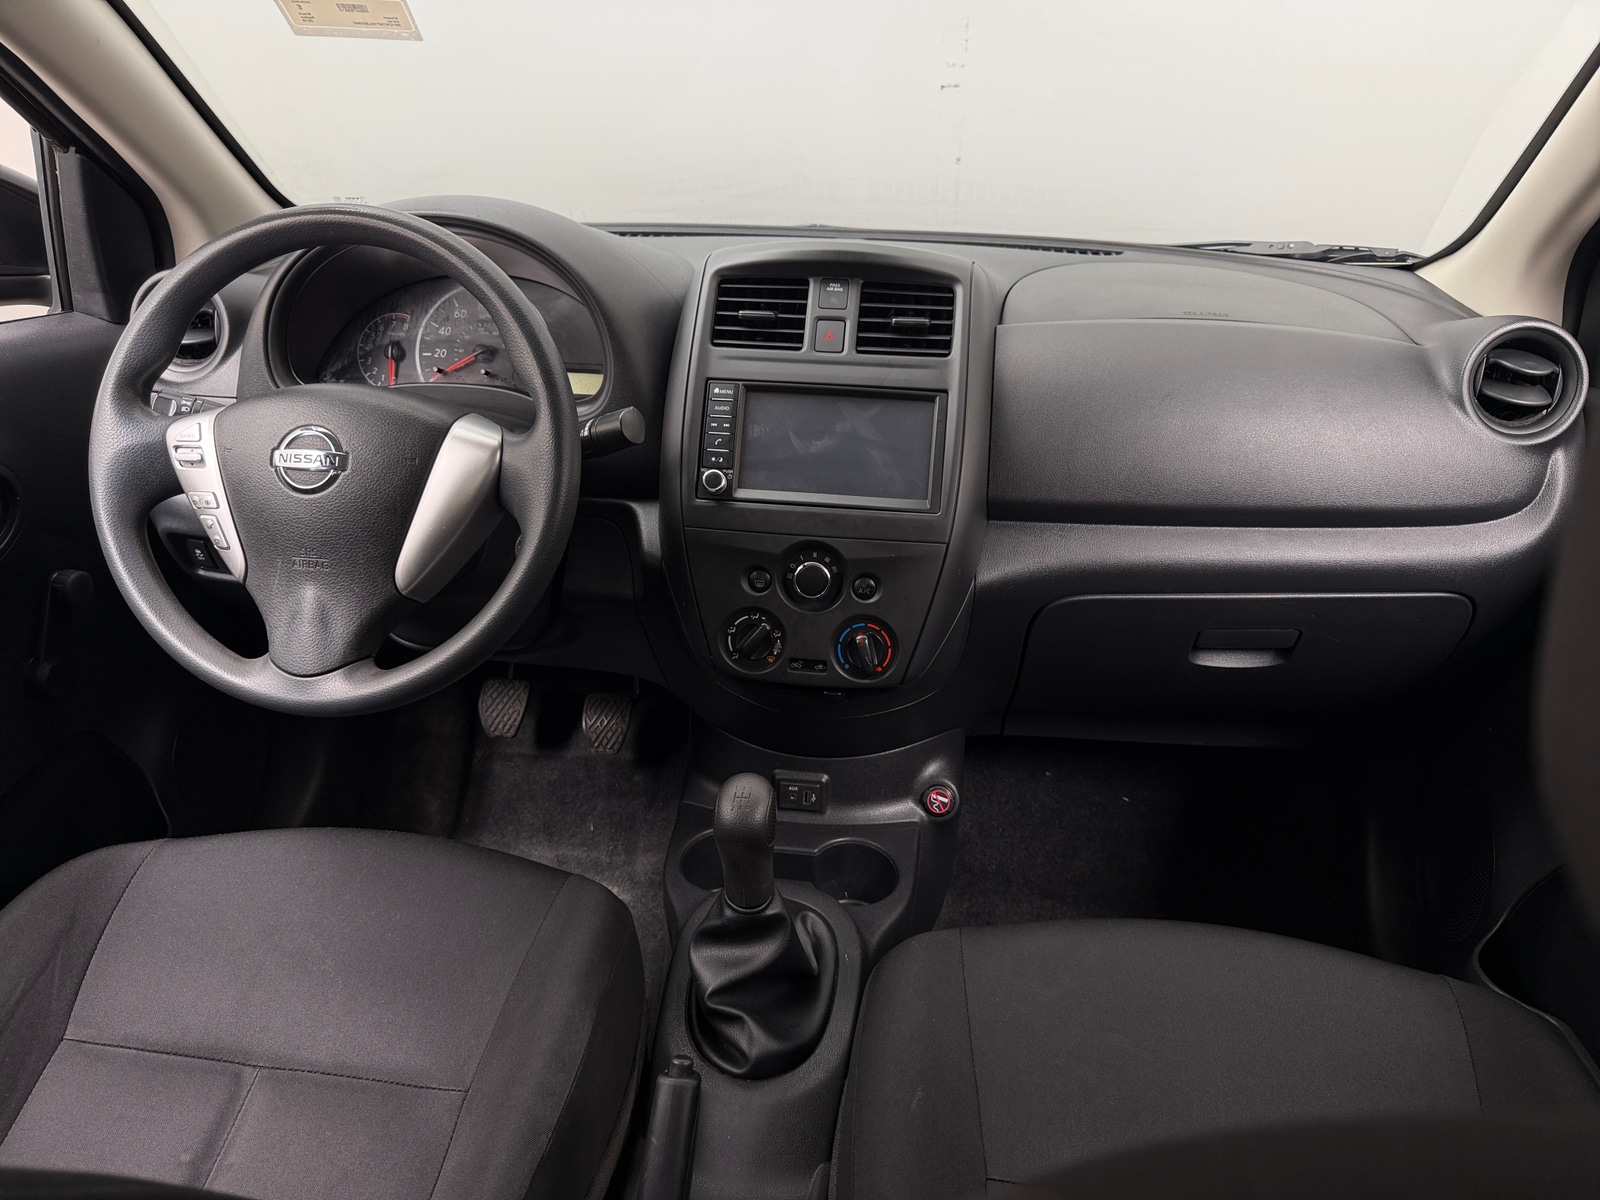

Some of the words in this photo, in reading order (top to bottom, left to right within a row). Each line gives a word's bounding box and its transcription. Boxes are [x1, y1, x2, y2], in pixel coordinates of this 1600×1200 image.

[454, 309, 467, 318] 60
[438, 326, 452, 336] 40
[434, 348, 447, 358] 20
[278, 453, 339, 466] NISSAN
[291, 560, 329, 570] AIRBAG
